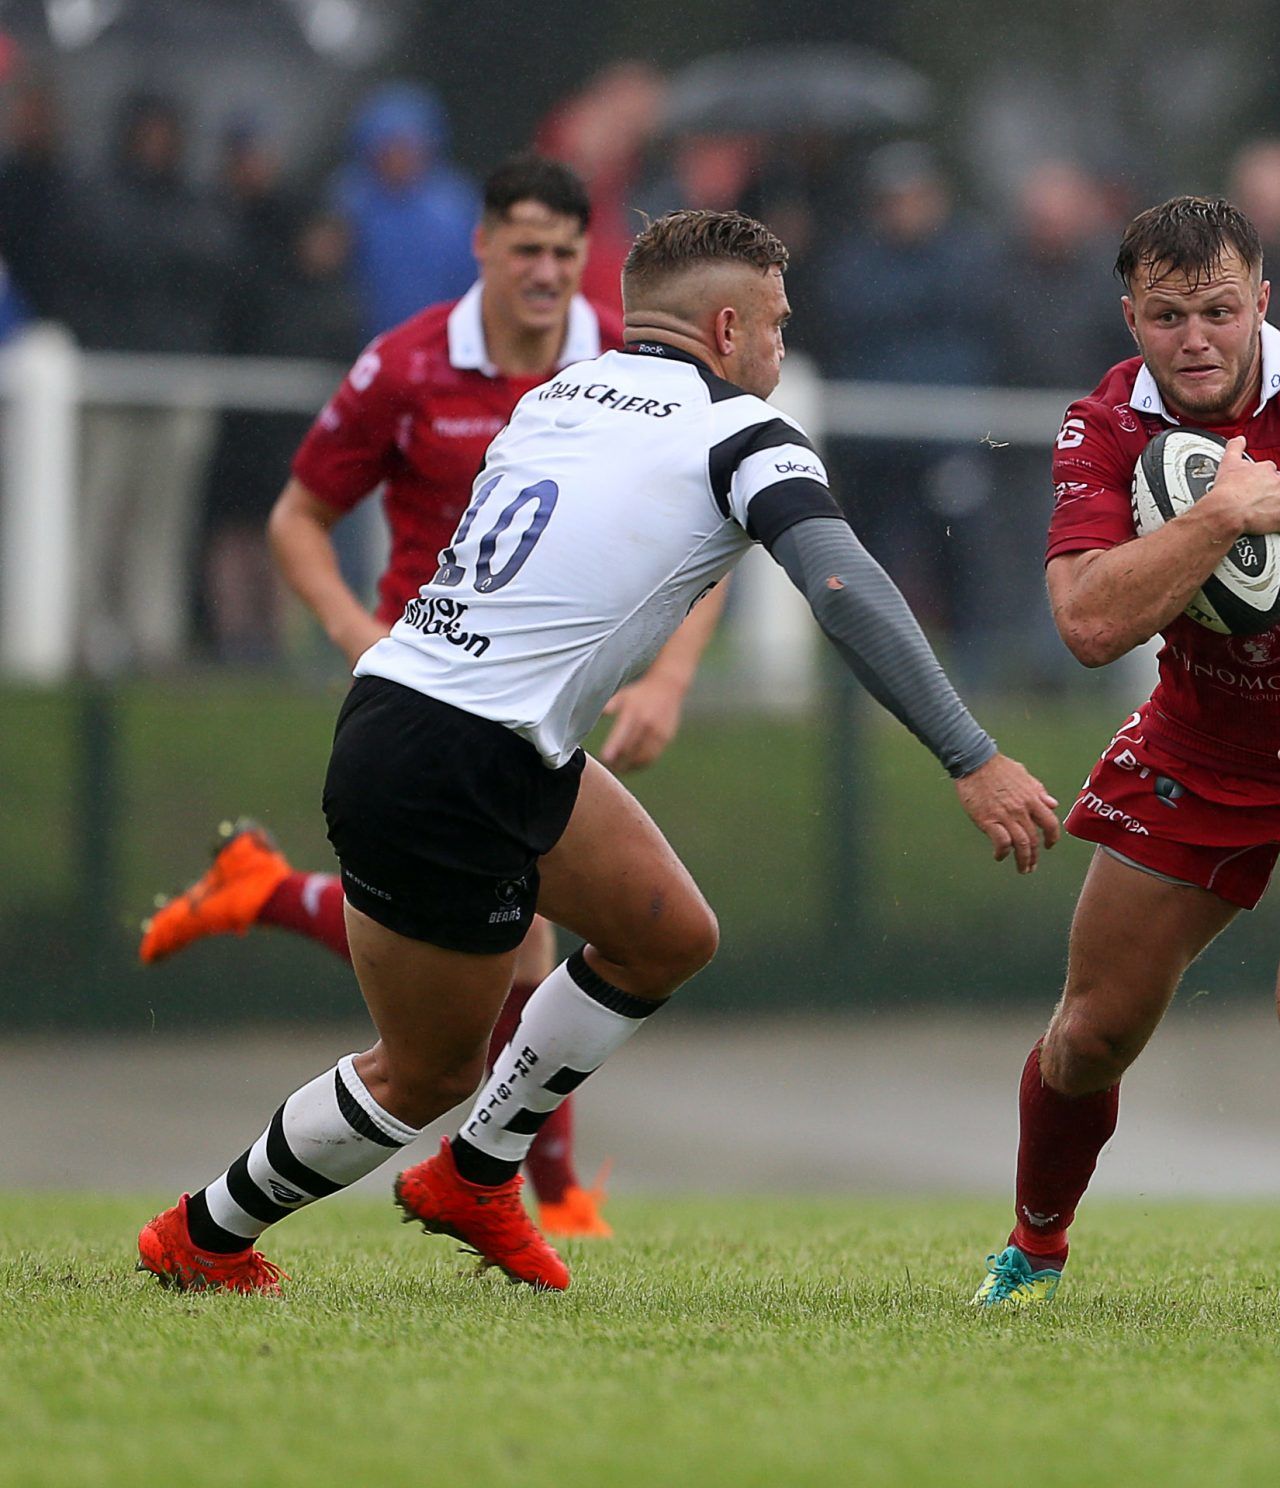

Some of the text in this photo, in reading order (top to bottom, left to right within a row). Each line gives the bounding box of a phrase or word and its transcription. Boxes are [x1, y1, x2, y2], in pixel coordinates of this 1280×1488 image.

[432, 474, 559, 594] 10
[488, 907, 521, 924] BEARS
[468, 1046, 539, 1137] BRISTOL
